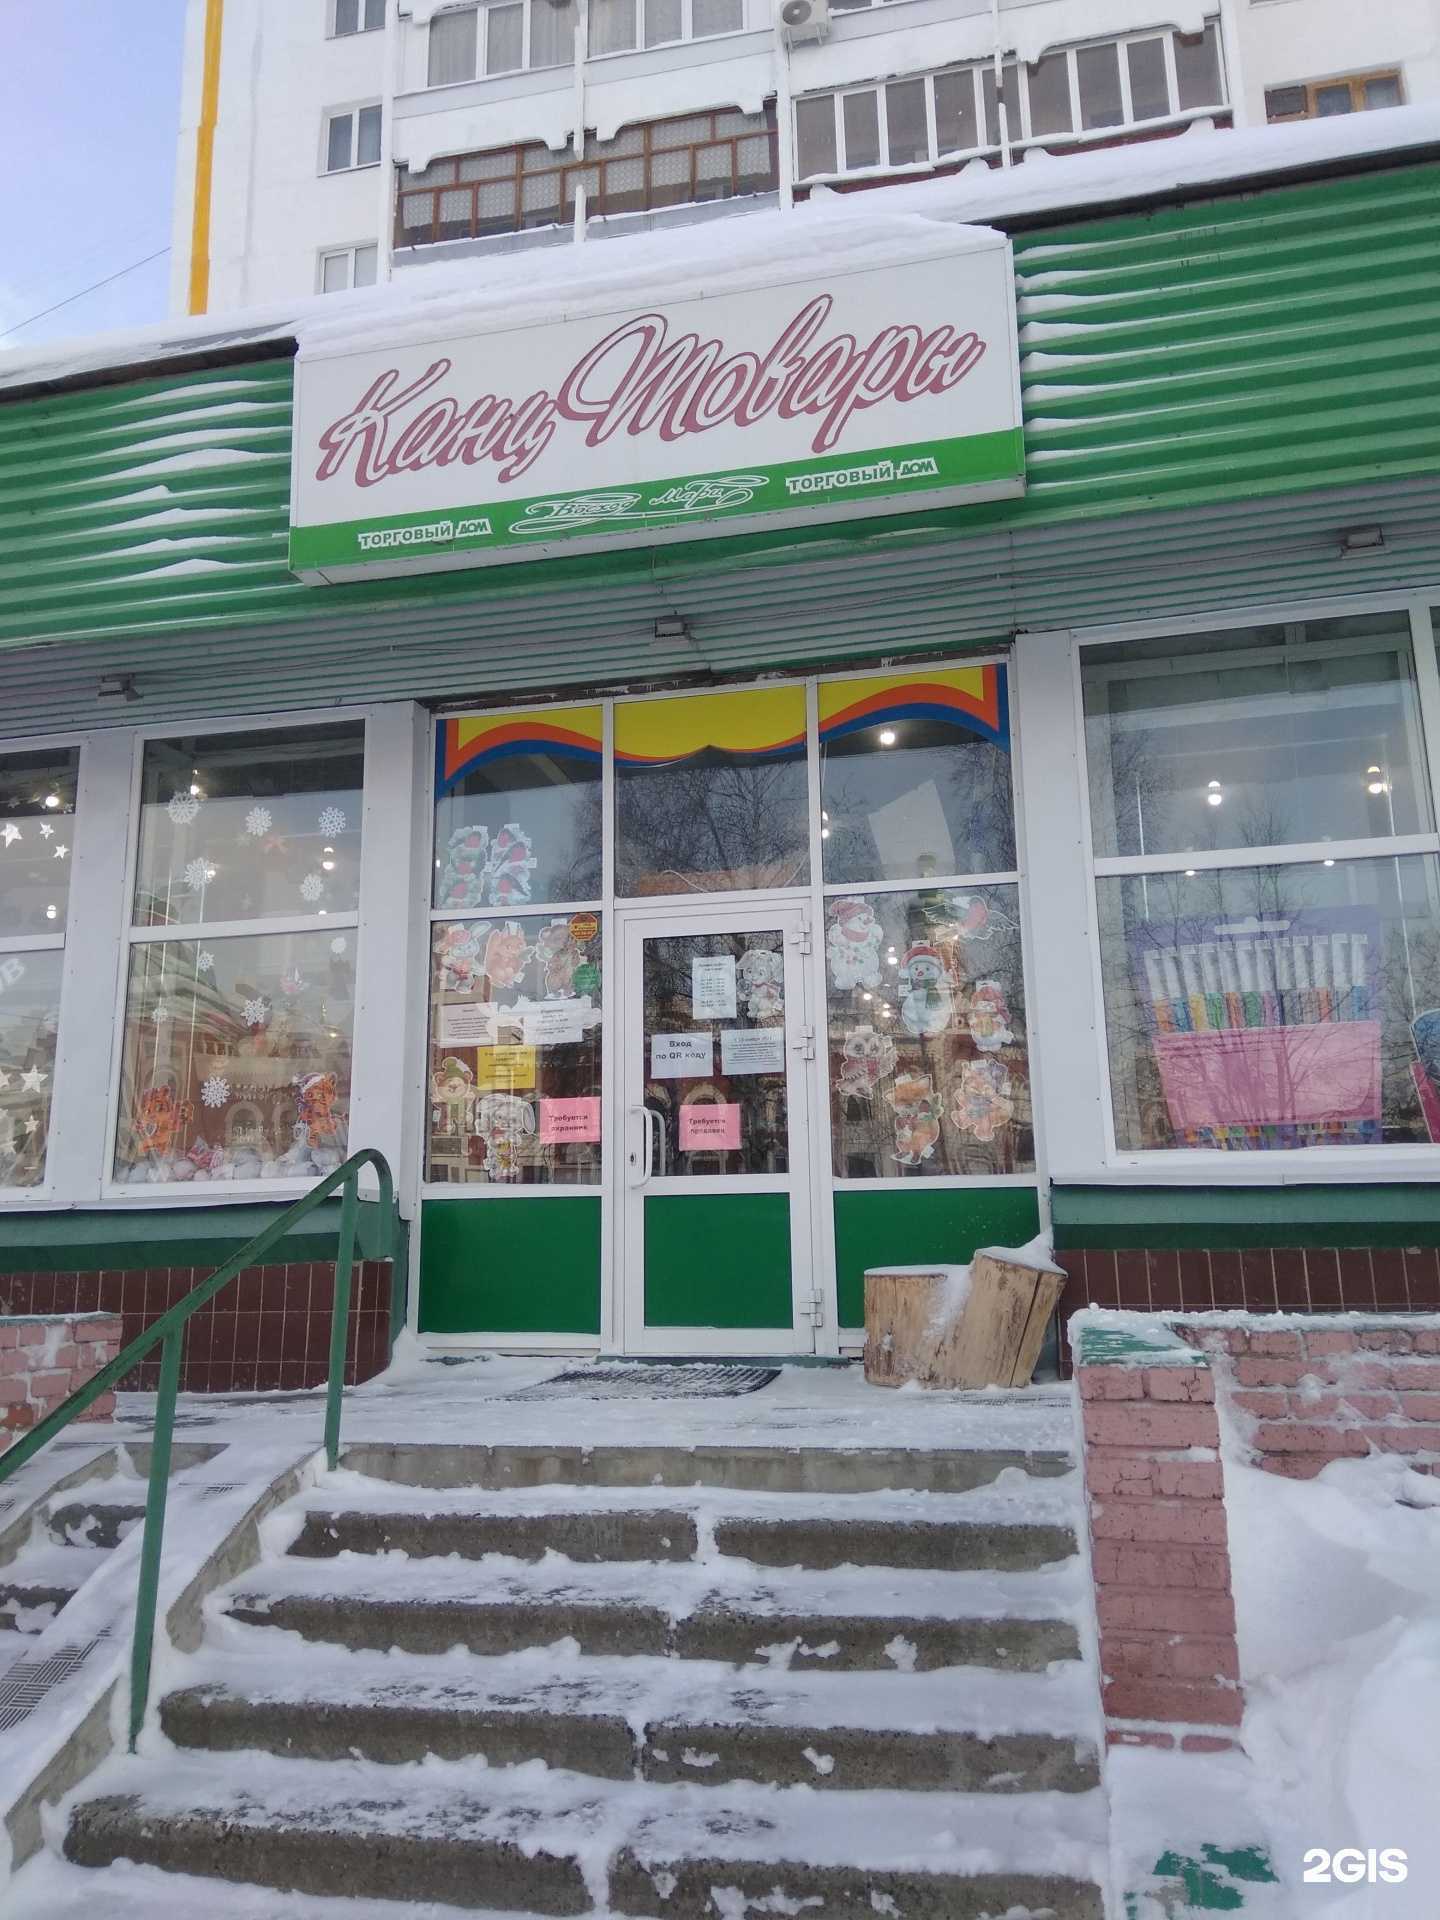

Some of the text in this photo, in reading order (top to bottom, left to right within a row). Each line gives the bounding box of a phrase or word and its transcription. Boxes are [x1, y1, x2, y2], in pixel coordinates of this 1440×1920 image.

[786, 457, 938, 494] ТОРГОВЫЙ ДОМ
[359, 518, 493, 550] ТОРГОВЫЙ ДОМ
[669, 1040, 692, 1048] Вход
[669, 1051, 682, 1060] QR
